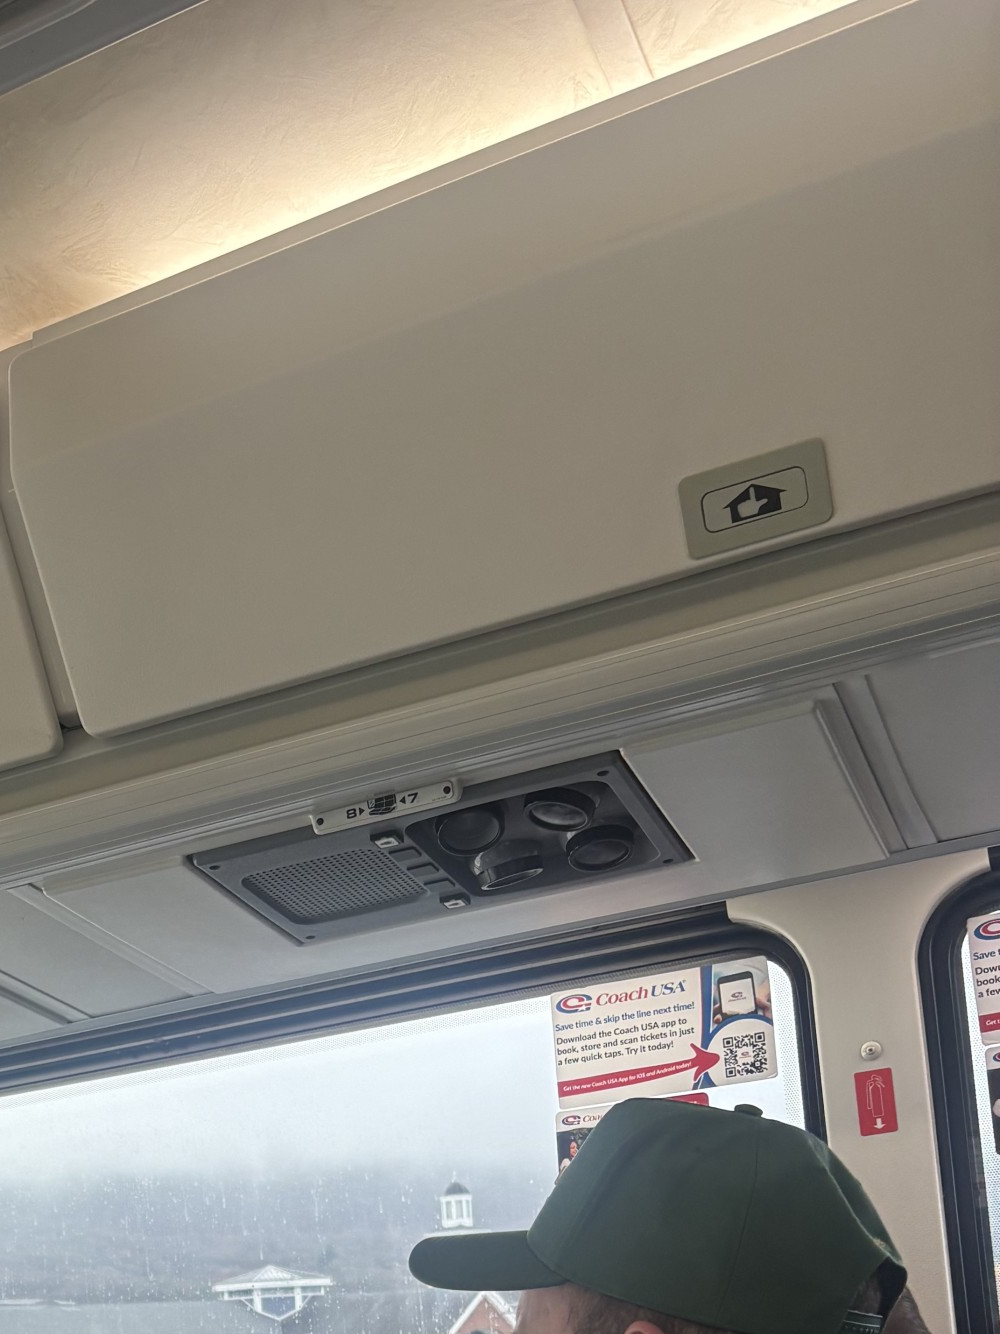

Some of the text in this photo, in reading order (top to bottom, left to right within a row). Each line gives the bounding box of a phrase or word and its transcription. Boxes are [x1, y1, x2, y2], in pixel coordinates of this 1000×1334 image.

[346, 808, 357, 820] 8
[408, 792, 418, 804] 7
[596, 981, 686, 1006] Coach USA
[555, 1024, 574, 1032] Save
[576, 1020, 593, 1028] time
[604, 1015, 620, 1024] skip
[637, 1010, 652, 1018] line
[653, 1006, 671, 1015] next
[674, 1002, 695, 1012] time!
[556, 1032, 596, 1045] Download
[614, 1025, 639, 1036] Coach
[641, 1022, 659, 1030] USA
[661, 1020, 676, 1029] app
[557, 1046, 579, 1056] book,
[581, 1043, 601, 1051] store
[603, 1039, 618, 1048] and
[640, 1032, 667, 1043] tickets
[678, 1027, 695, 1038] just
[581, 1053, 603, 1064] quick
[604, 1051, 624, 1060] taps.
[625, 1047, 638, 1057] Try
[648, 1041, 674, 1052] today!
[656, 1066, 676, 1075] Android
